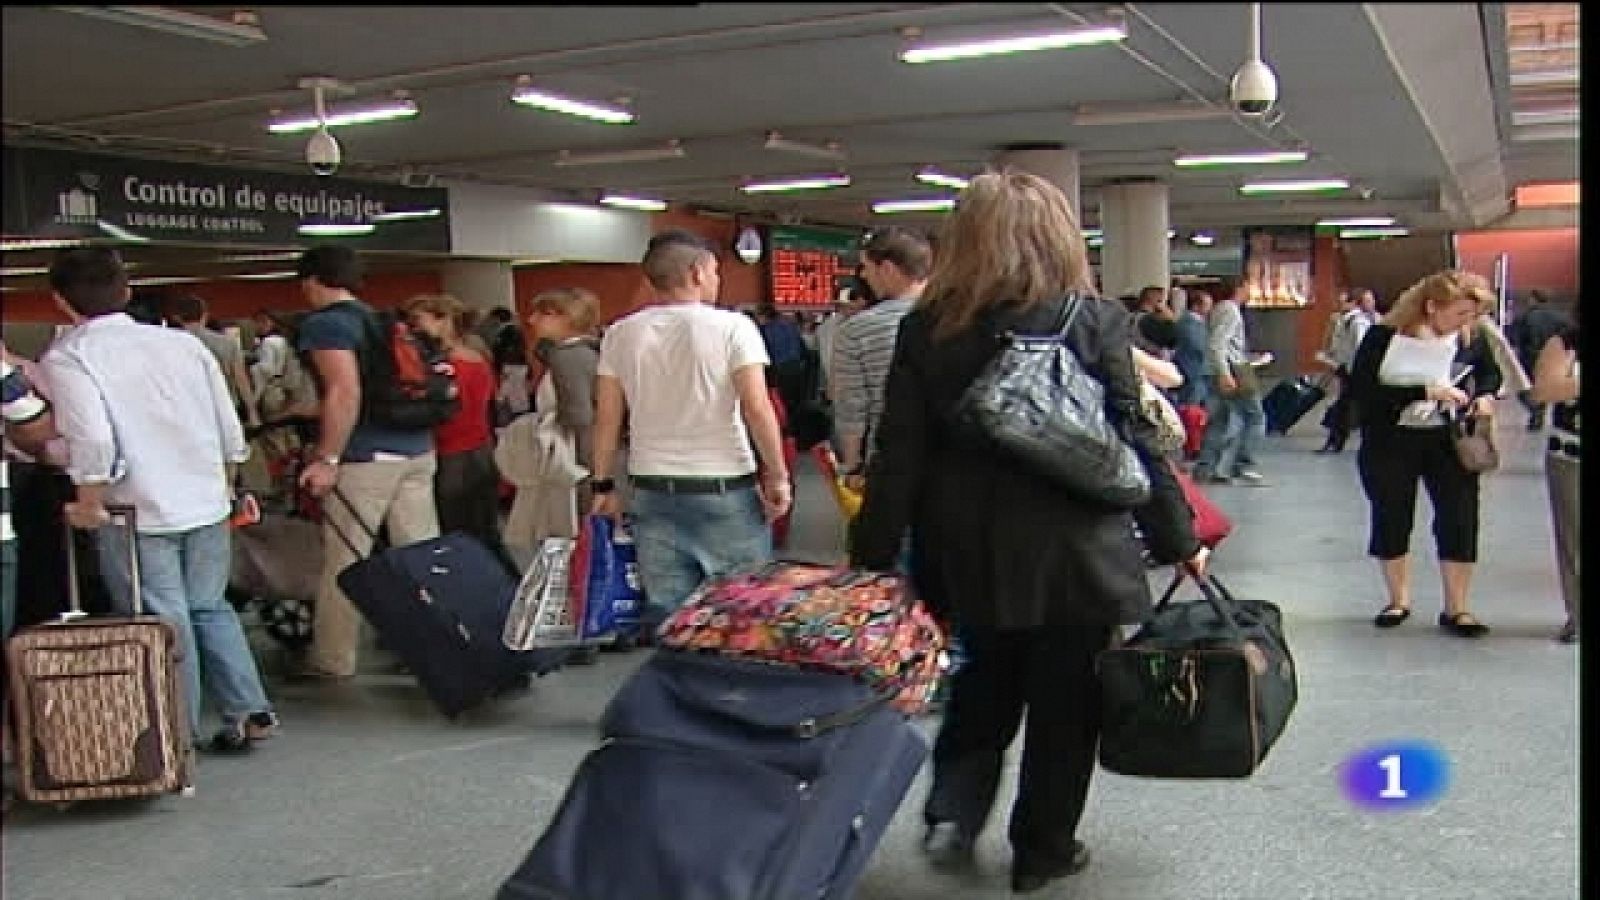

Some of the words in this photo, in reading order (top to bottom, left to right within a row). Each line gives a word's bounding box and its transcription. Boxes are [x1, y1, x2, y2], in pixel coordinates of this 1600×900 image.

[124, 175, 226, 211] Control
[234, 184, 266, 211] de
[274, 190, 384, 222] equipajes
